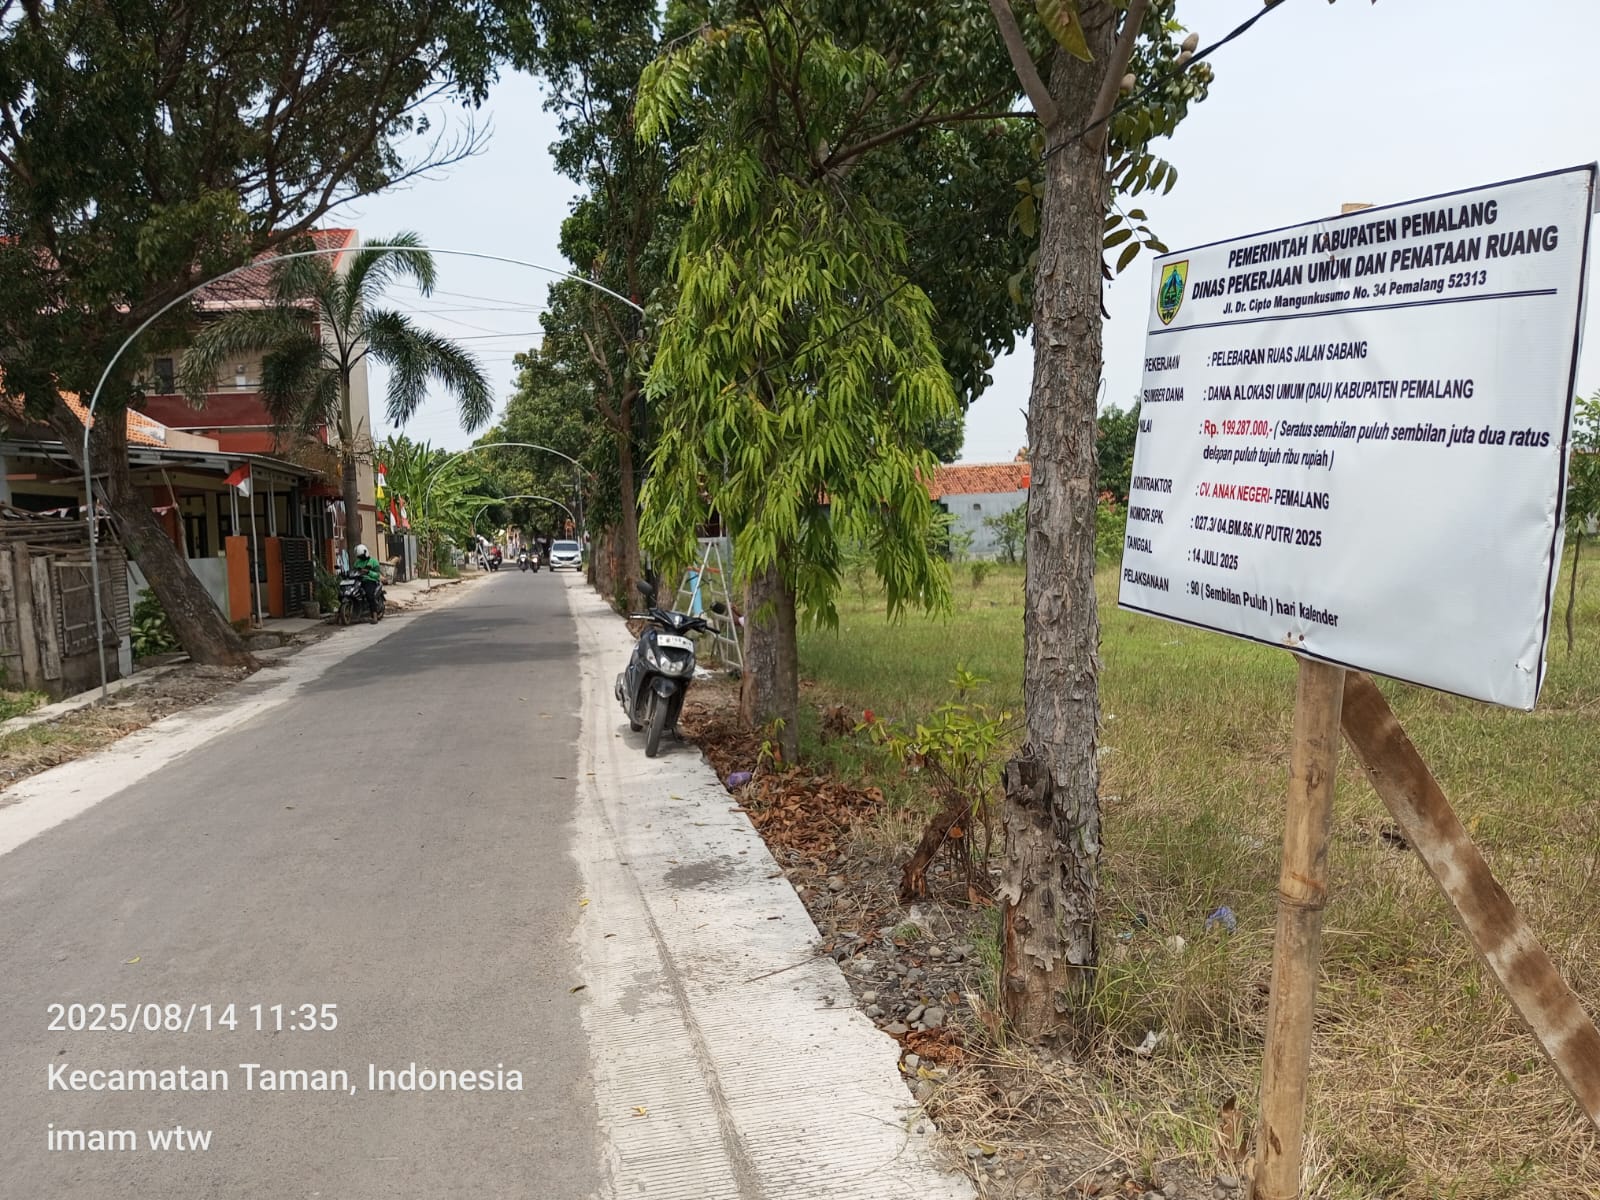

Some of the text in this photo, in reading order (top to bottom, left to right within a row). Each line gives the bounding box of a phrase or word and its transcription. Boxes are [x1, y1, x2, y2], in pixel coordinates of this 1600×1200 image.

[1228, 200, 1498, 268] PEMERINTAH KABUPATEN PEMALANG
[1192, 226, 1558, 300] DINAS PEKERJAAN UMUM DAN PENATAAN RUANG
[1236, 300, 1246, 313] Dr.
[1250, 298, 1272, 313] Cipto
[1274, 290, 1350, 309] Mangunkusumo
[1352, 286, 1370, 300] No.
[1373, 283, 1386, 298] 34
[1389, 278, 1444, 296] Pemalang
[1448, 270, 1487, 288] 52313
[1145, 355, 1180, 372] PEKERJAAN
[1212, 348, 1265, 366] PELEBARAN
[1267, 346, 1292, 364] RUAS
[1294, 344, 1326, 362] JALAN
[1326, 341, 1367, 360] SABANG
[1166, 387, 1184, 402] DANA
[1208, 386, 1230, 400] DANA
[1234, 384, 1274, 400] ALOKASI
[1277, 383, 1304, 400] UMUM
[1306, 382, 1332, 402] (DAU)
[1334, 380, 1398, 399] KABUPATEN
[1400, 379, 1474, 398] PEMALANG
[1204, 420, 1218, 438] Rp.
[1280, 420, 1312, 438] Seratus
[1313, 422, 1356, 439] sembilan
[1357, 422, 1389, 443] puluh
[1391, 423, 1446, 442] sembilan
[1446, 424, 1475, 447] juta
[1478, 425, 1506, 445] dua
[1508, 427, 1550, 448] ratus
[1204, 446, 1232, 464] delapan
[1233, 446, 1257, 464] puluh
[1258, 448, 1281, 466] tujuh
[1282, 449, 1299, 464] ribu
[1301, 450, 1328, 469] rupiah
[1133, 476, 1172, 494] KONTRAKTOR
[1200, 482, 1210, 496] CV.
[1212, 483, 1236, 500] ANAK
[1274, 488, 1329, 510] PEMALANG
[1150, 509, 1164, 524] SPK
[1296, 529, 1322, 547] 2025
[1127, 536, 1152, 554] TANGGAL
[1192, 548, 1200, 562] 14
[1202, 549, 1218, 566] JULI
[1220, 554, 1238, 570] 2025
[1124, 568, 1169, 592] PELAKSANAAN
[1190, 580, 1200, 596] 90
[1206, 584, 1242, 605] Sembilan
[1243, 592, 1268, 612] Puluh
[1276, 599, 1296, 616] hari
[1300, 602, 1338, 627] kalender
